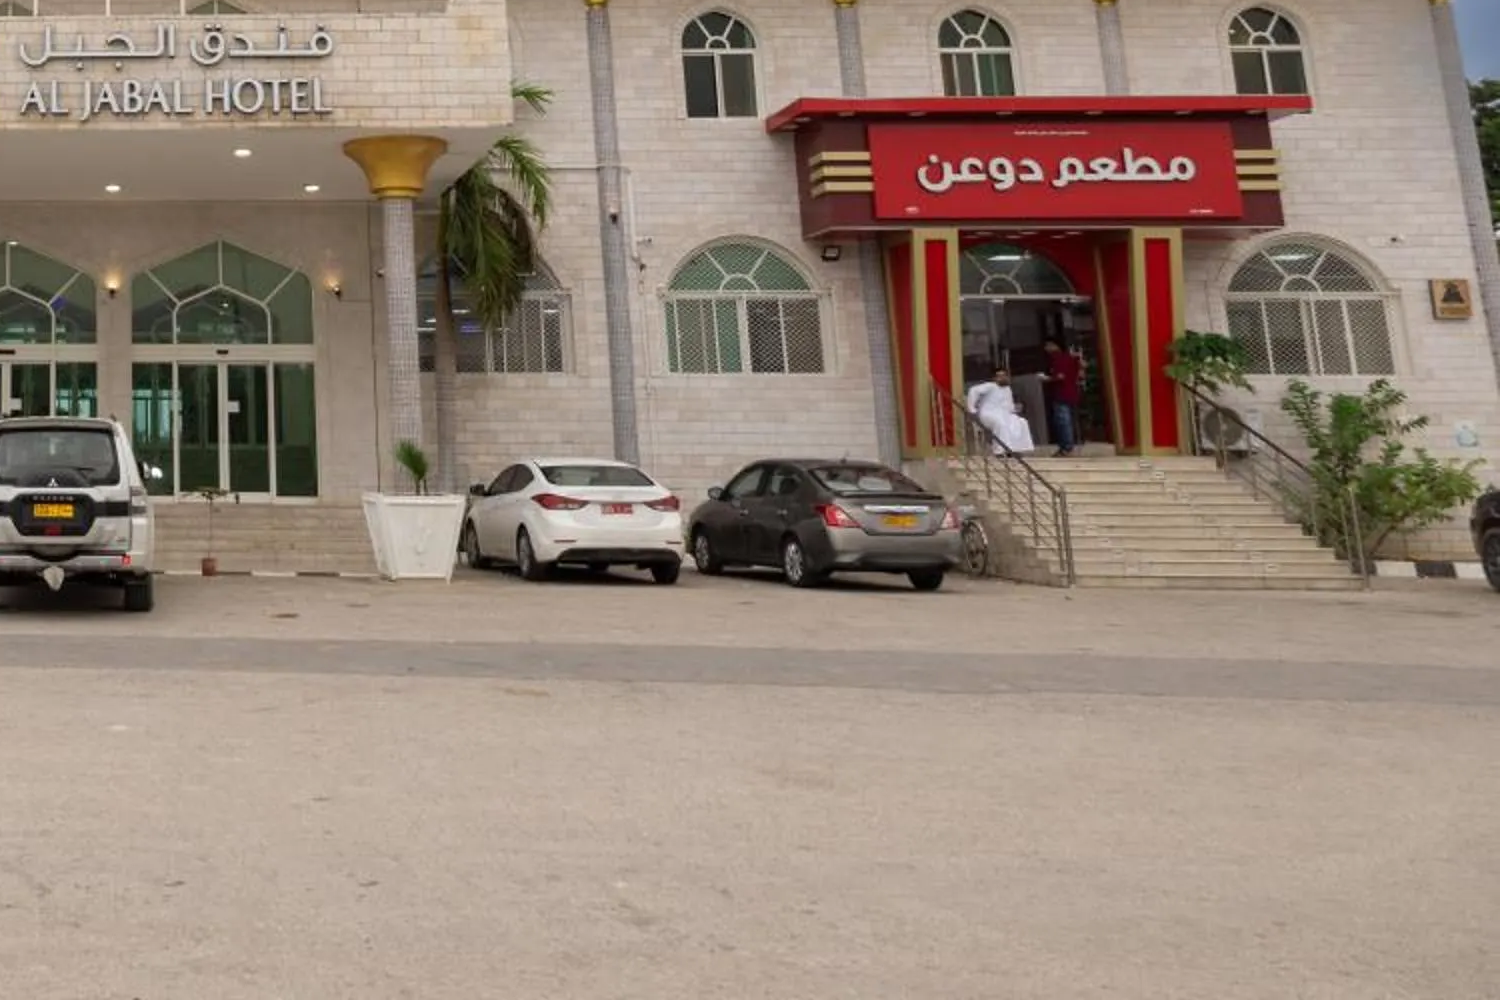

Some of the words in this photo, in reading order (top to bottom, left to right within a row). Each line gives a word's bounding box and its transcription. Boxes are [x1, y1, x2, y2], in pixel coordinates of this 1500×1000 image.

[19, 22, 177, 71] الجبل
[190, 23, 334, 67] فندق
[20, 80, 69, 116] AL
[78, 79, 195, 122] JABAL
[204, 76, 333, 114] HOTEL
[916, 153, 1045, 194] دوعن
[1051, 147, 1197, 188] مطعم
